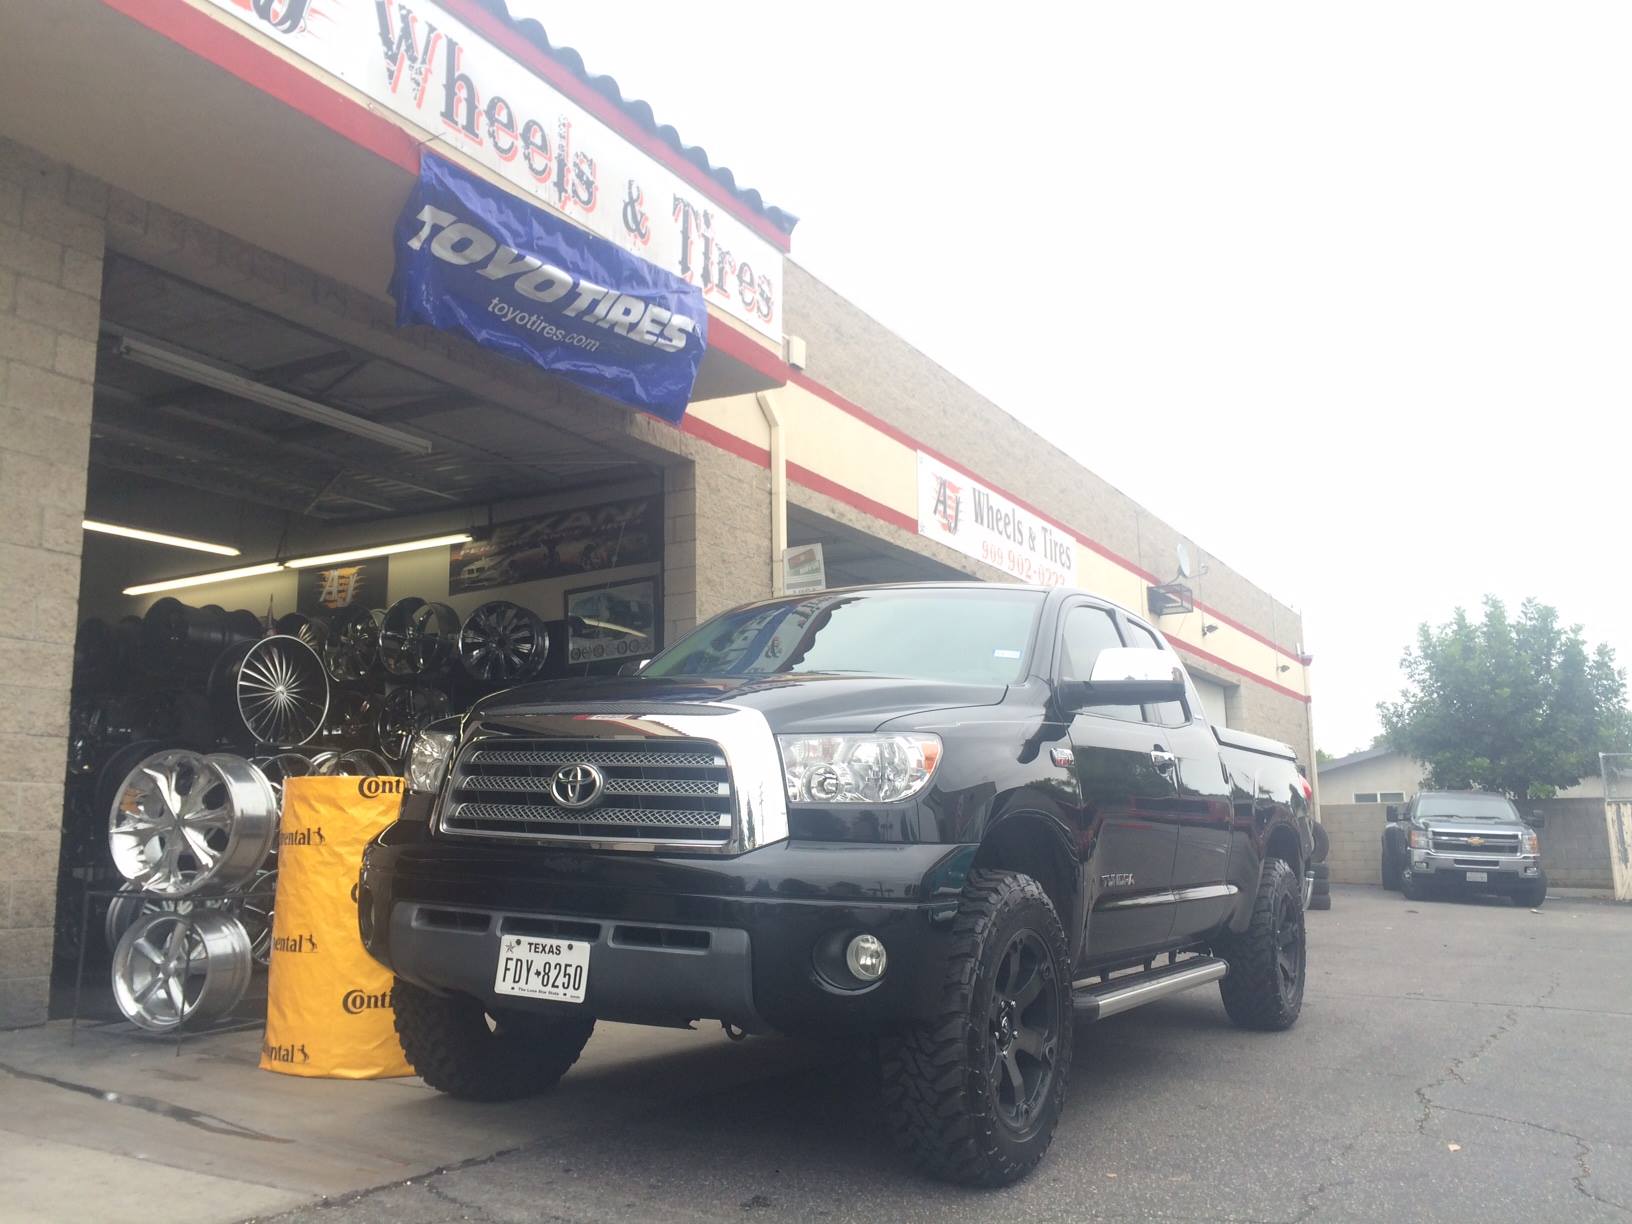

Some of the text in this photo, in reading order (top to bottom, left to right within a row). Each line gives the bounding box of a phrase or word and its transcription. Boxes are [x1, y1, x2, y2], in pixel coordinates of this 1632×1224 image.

[375, 0, 774, 324] Wheels & Tires
[407, 204, 698, 353] TOYO TIRES
[487, 296, 600, 353] toyotires.com
[972, 486, 1024, 547] Wheels
[1027, 525, 1037, 553] &
[1041, 525, 1072, 571] Tires
[528, 942, 562, 956] TEXAS
